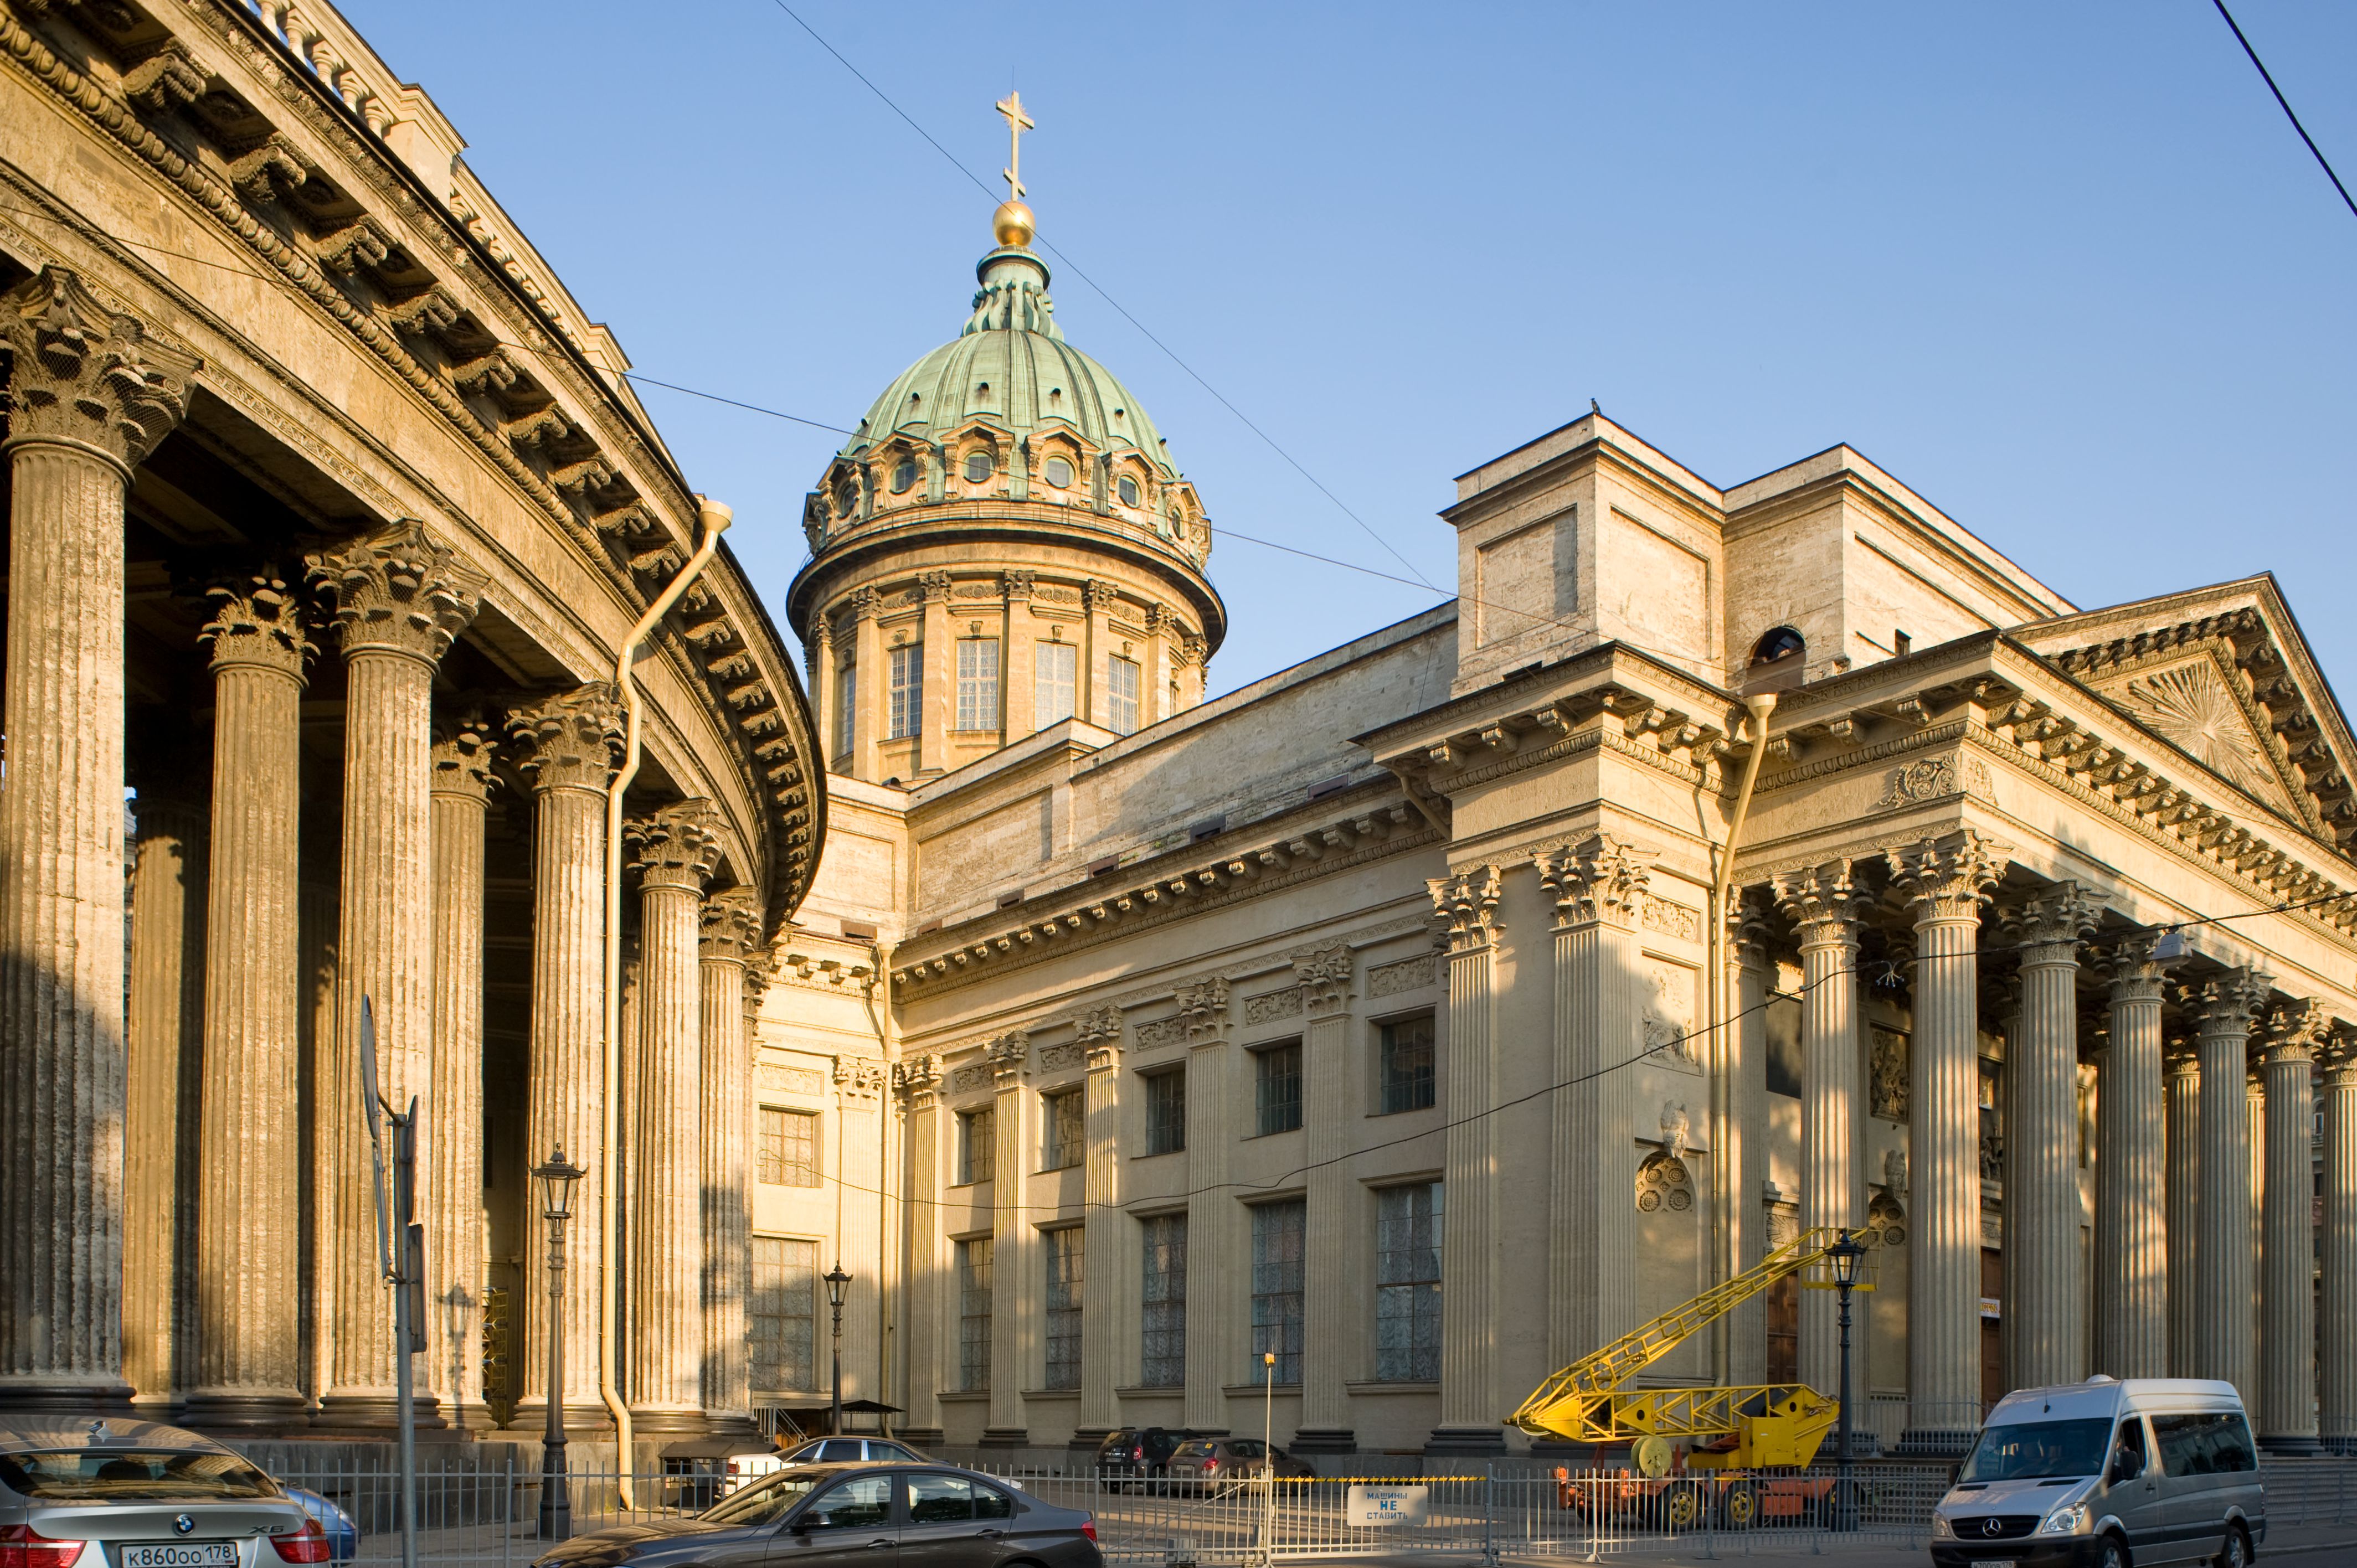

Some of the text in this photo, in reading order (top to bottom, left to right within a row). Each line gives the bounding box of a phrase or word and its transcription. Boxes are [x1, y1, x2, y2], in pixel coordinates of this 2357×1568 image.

[1380, 1500, 1397, 1510] НЕ
[249, 1525, 284, 1534] X6
[205, 1546, 230, 1559] 178
